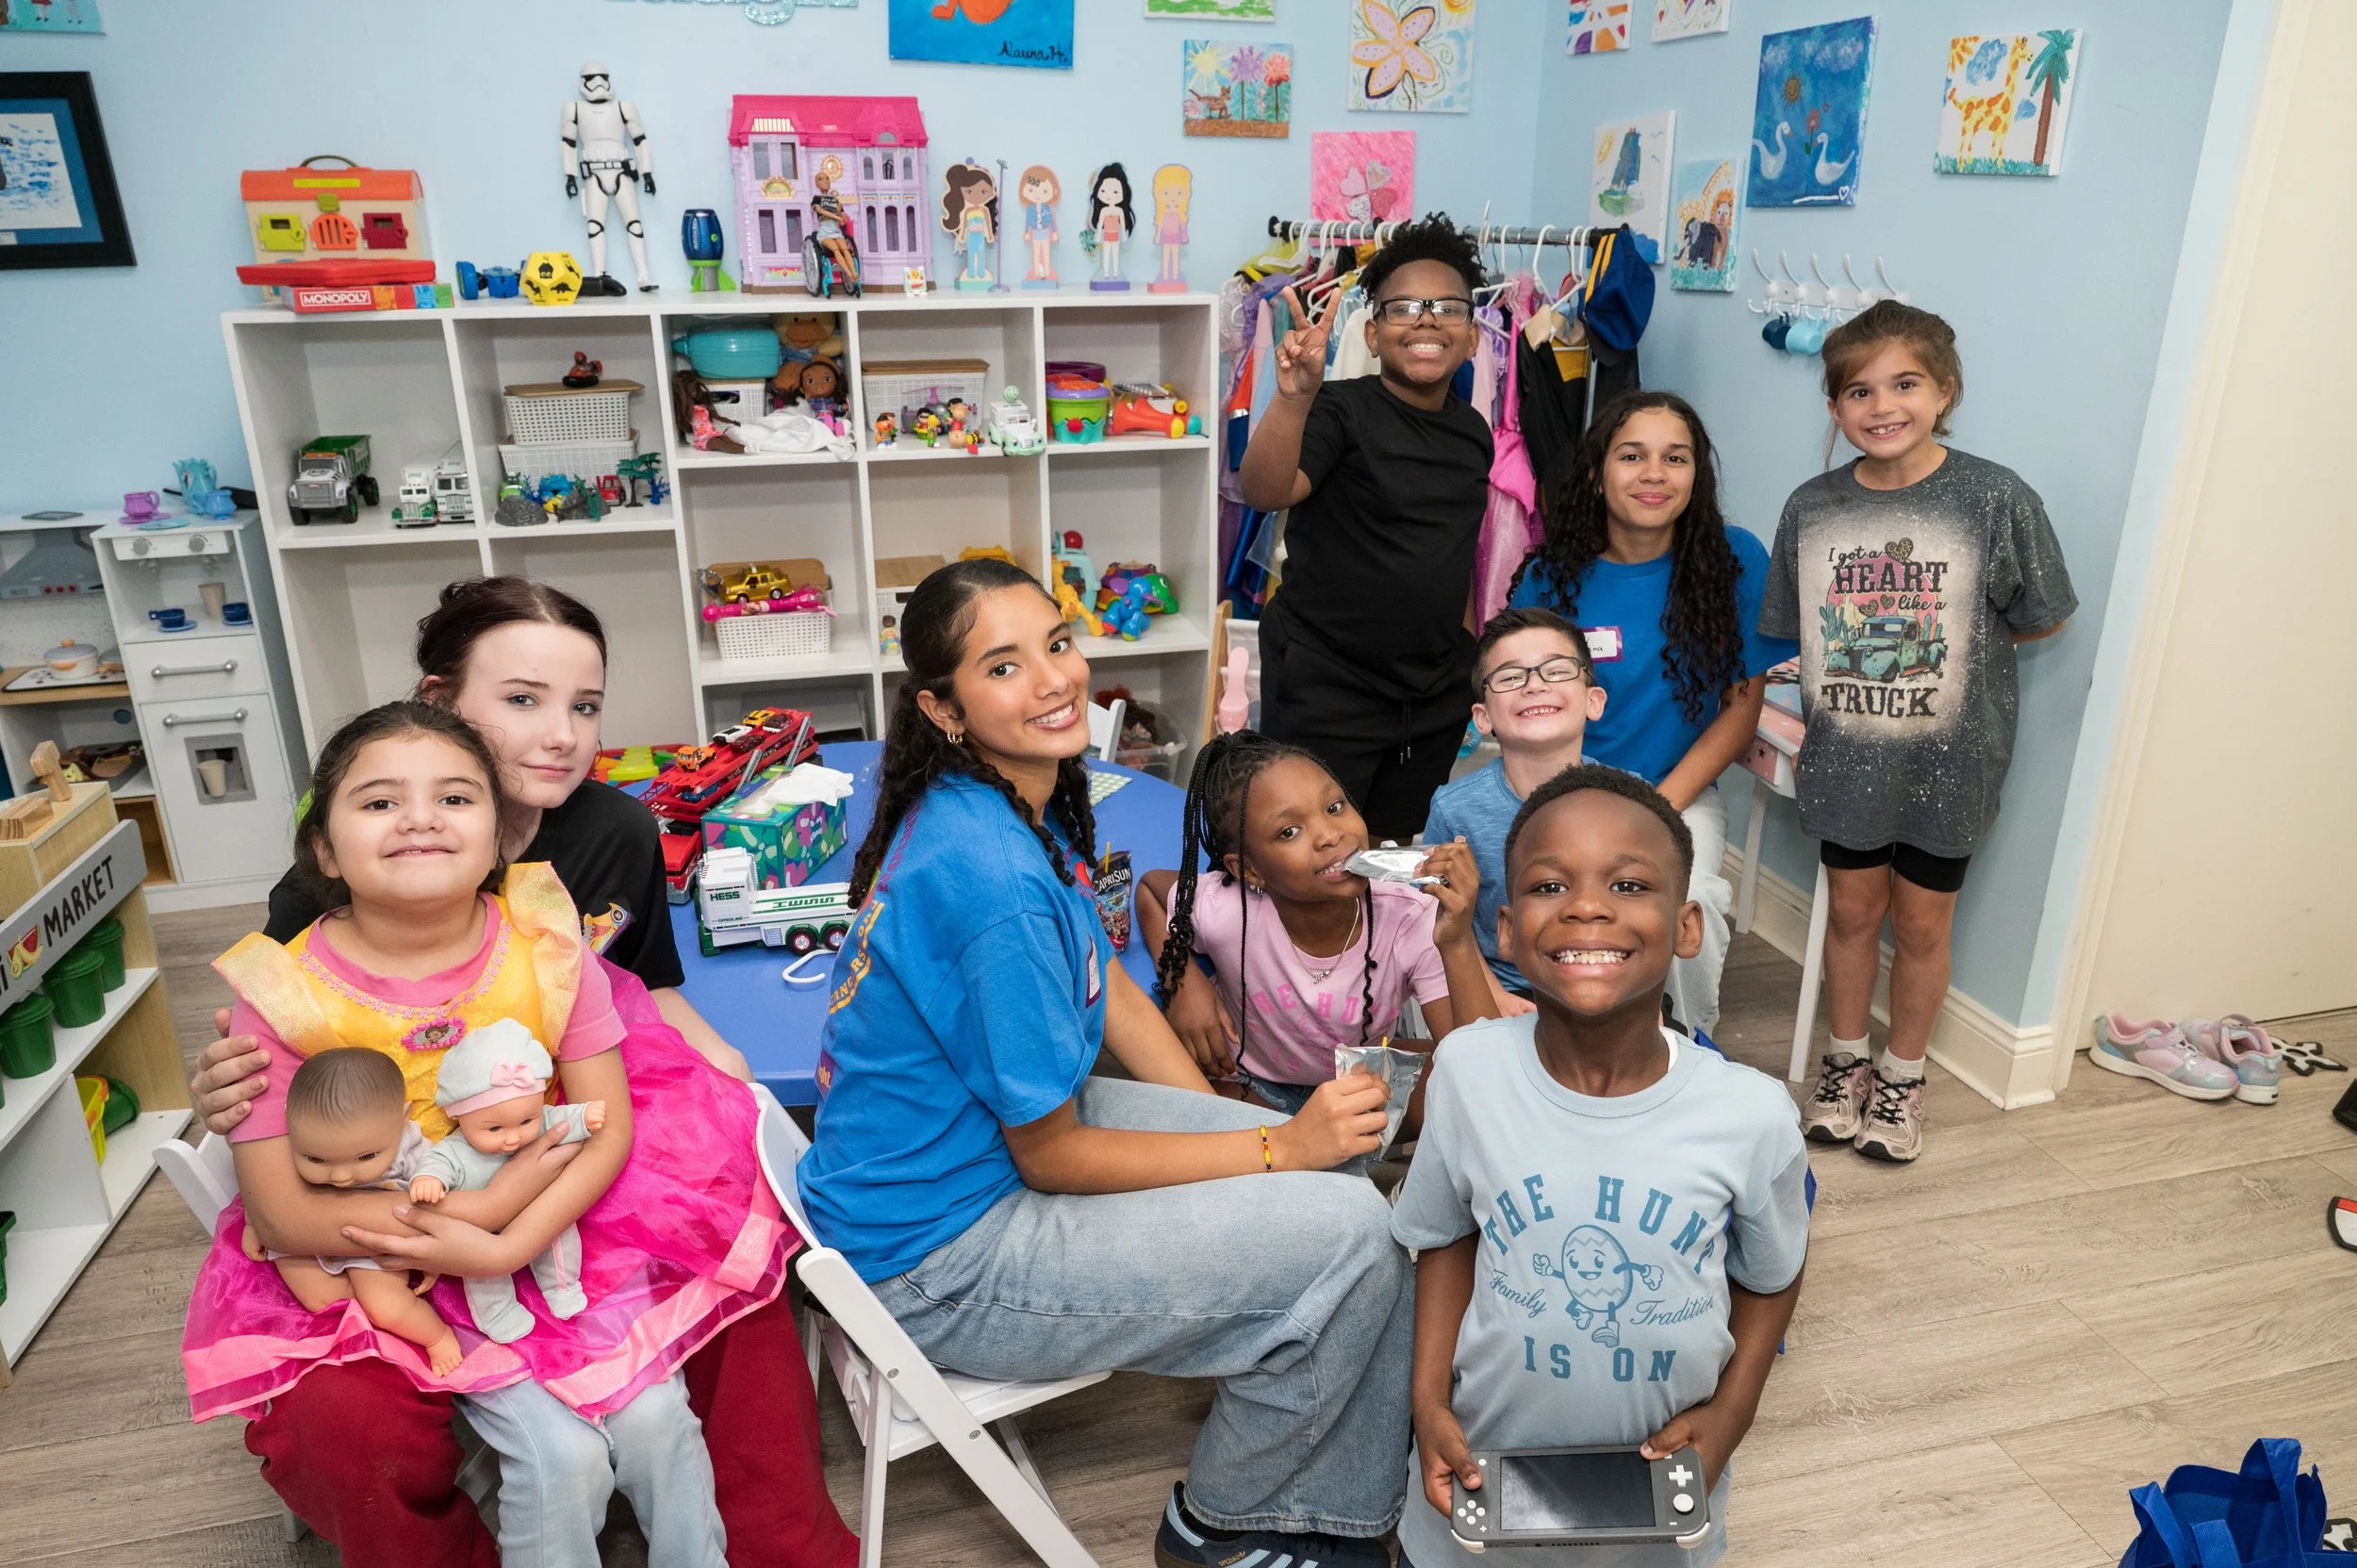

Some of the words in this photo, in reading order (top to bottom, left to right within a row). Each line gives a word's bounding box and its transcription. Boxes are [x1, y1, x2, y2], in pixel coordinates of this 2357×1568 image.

[303, 292, 369, 305] MONOPOLY
[1827, 547, 1836, 562] I
[1838, 545, 1867, 566] got
[1868, 550, 1883, 559] a
[1832, 560, 1949, 594] HEART
[1897, 594, 1932, 611] like
[1934, 601, 1948, 611] a
[1821, 682, 1939, 718] TRUCK
[710, 891, 741, 901] HESS
[1094, 868, 1130, 895] CAPRISUN
[43, 854, 114, 948] MARKET
[1483, 1173, 1555, 1256] THE
[1594, 1175, 1715, 1275] HUNT
[1490, 1268, 1547, 1319] Family
[1629, 1294, 1714, 1326] Tradition
[1524, 1335, 1571, 1379] IS
[1613, 1347, 1677, 1382] ON
